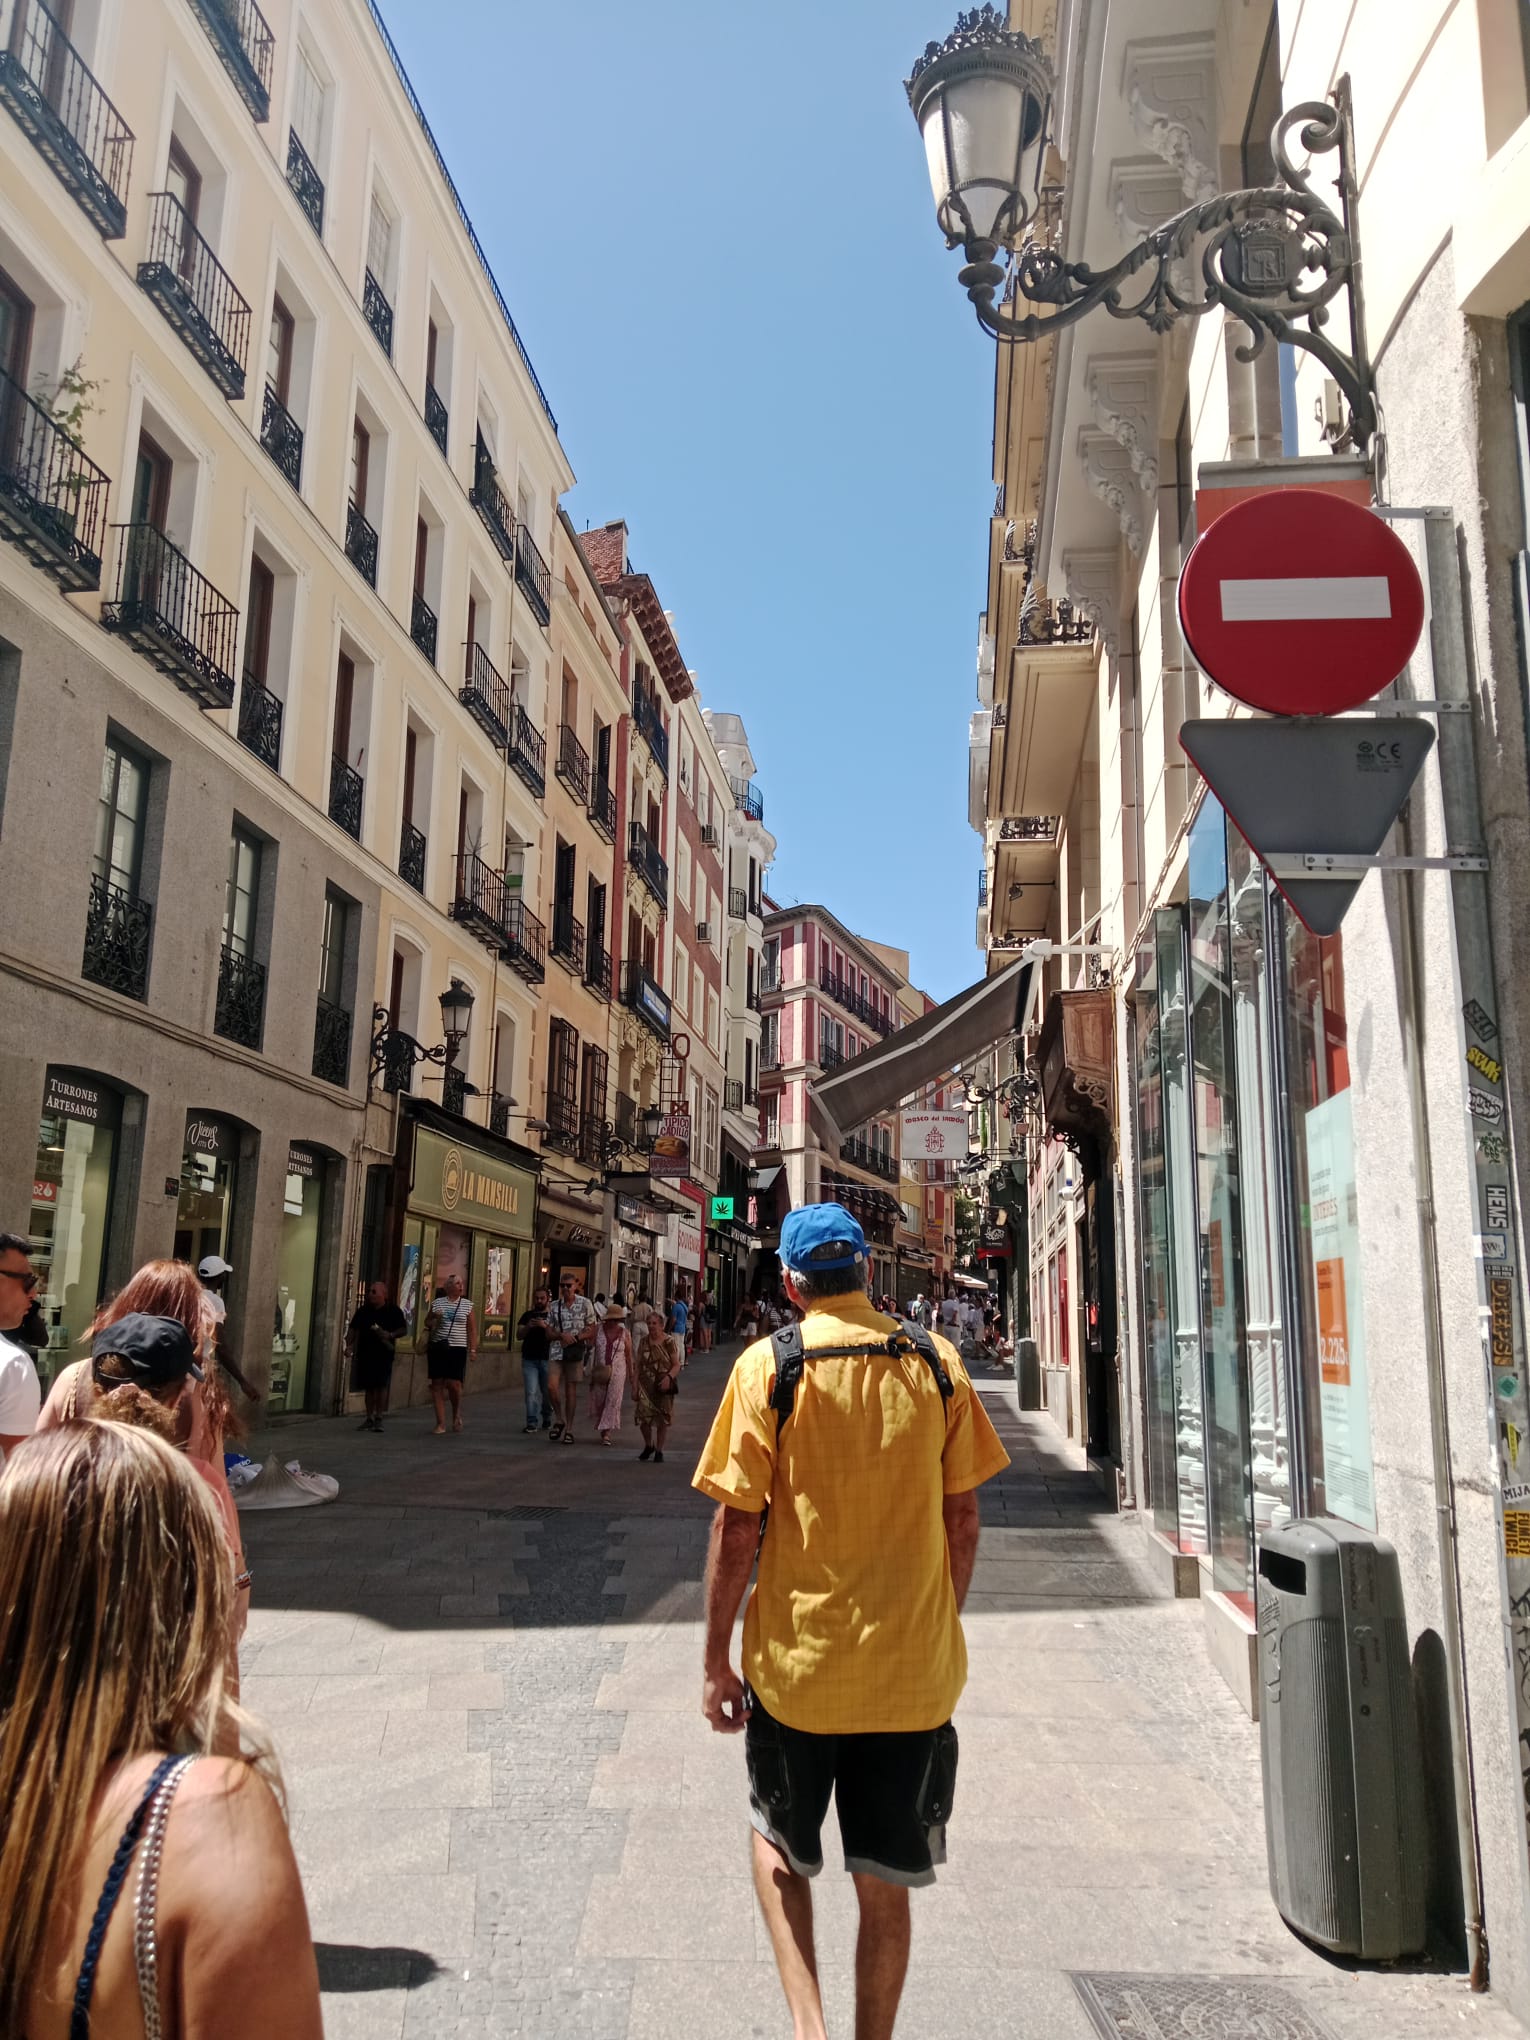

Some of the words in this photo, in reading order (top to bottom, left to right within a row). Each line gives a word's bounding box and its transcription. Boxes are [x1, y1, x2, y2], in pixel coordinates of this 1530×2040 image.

[50, 1078, 98, 1103] TURRONES
[45, 1095, 98, 1119] ARTESANOS
[288, 1161, 313, 1176] RTESANOS
[289, 1149, 313, 1164] URRONES
[462, 1169, 475, 1201] LA
[476, 1174, 518, 1216] MANSILLA
[1487, 1186, 1508, 1228] HEMS
[1505, 1512, 1518, 1555] TWICE
